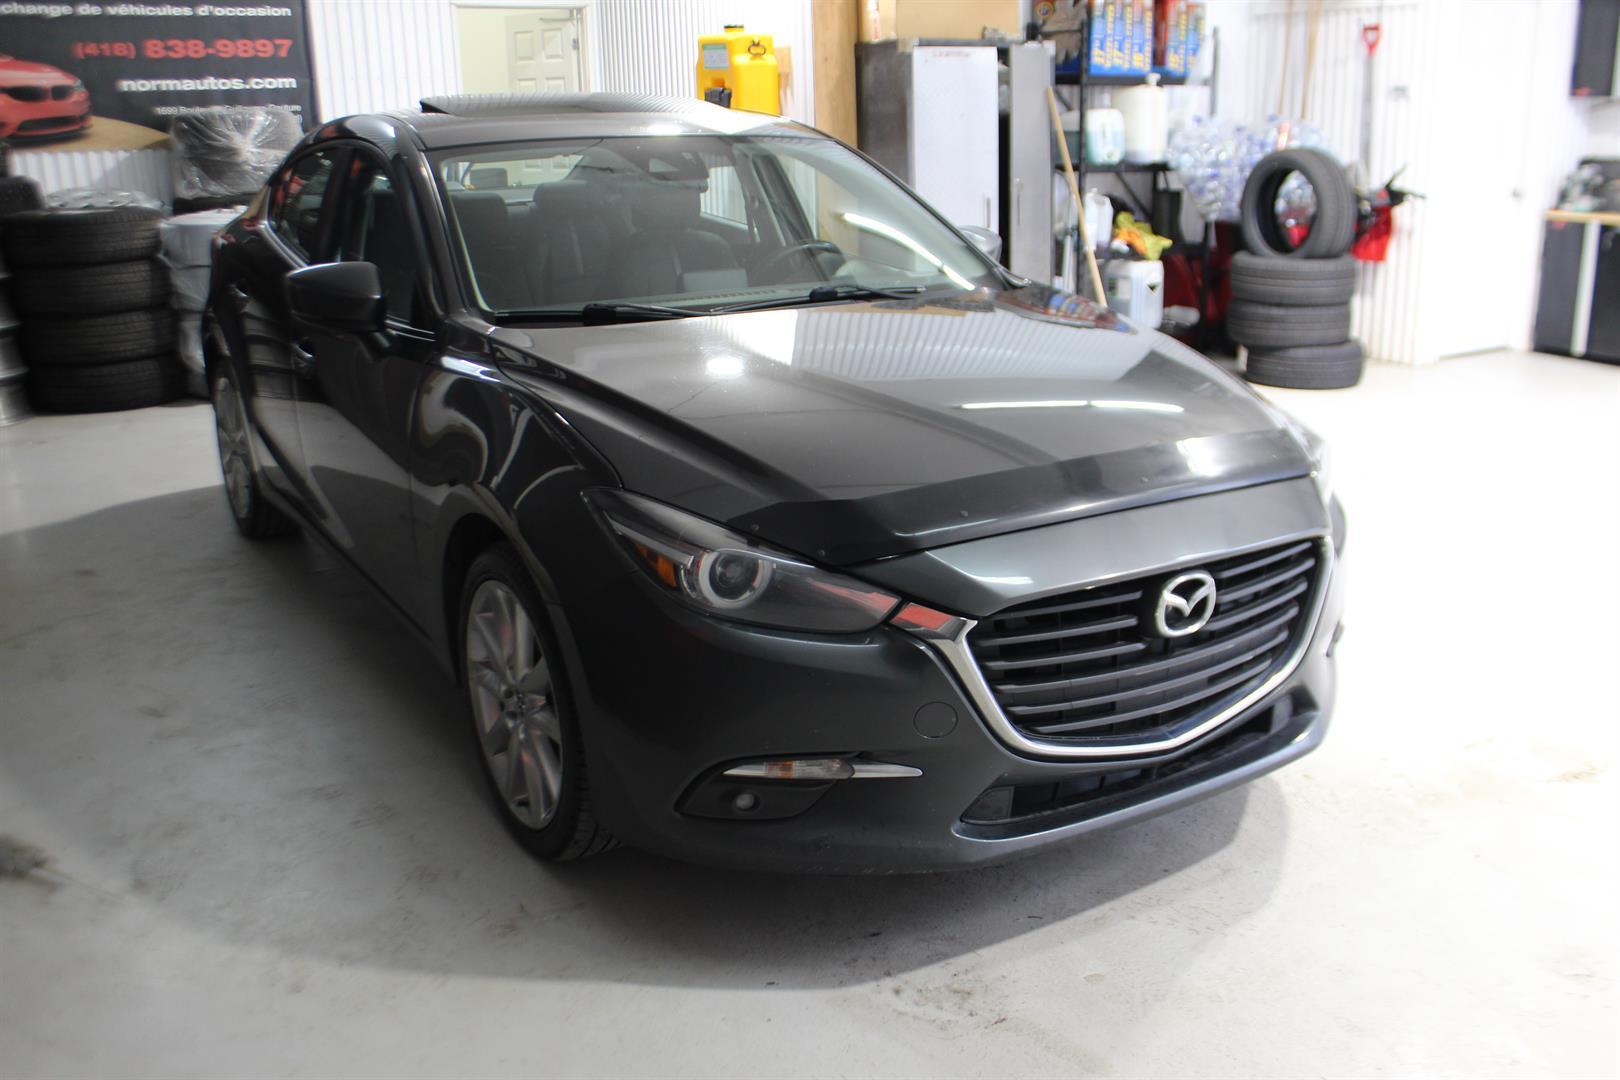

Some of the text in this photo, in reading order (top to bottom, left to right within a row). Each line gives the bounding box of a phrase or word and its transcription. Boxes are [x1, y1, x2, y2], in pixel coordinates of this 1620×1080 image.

[0, 3, 292, 19] change de véhicules d'occasion
[74, 38, 293, 59] (418) 838-9897
[118, 76, 298, 92] normautos.com
